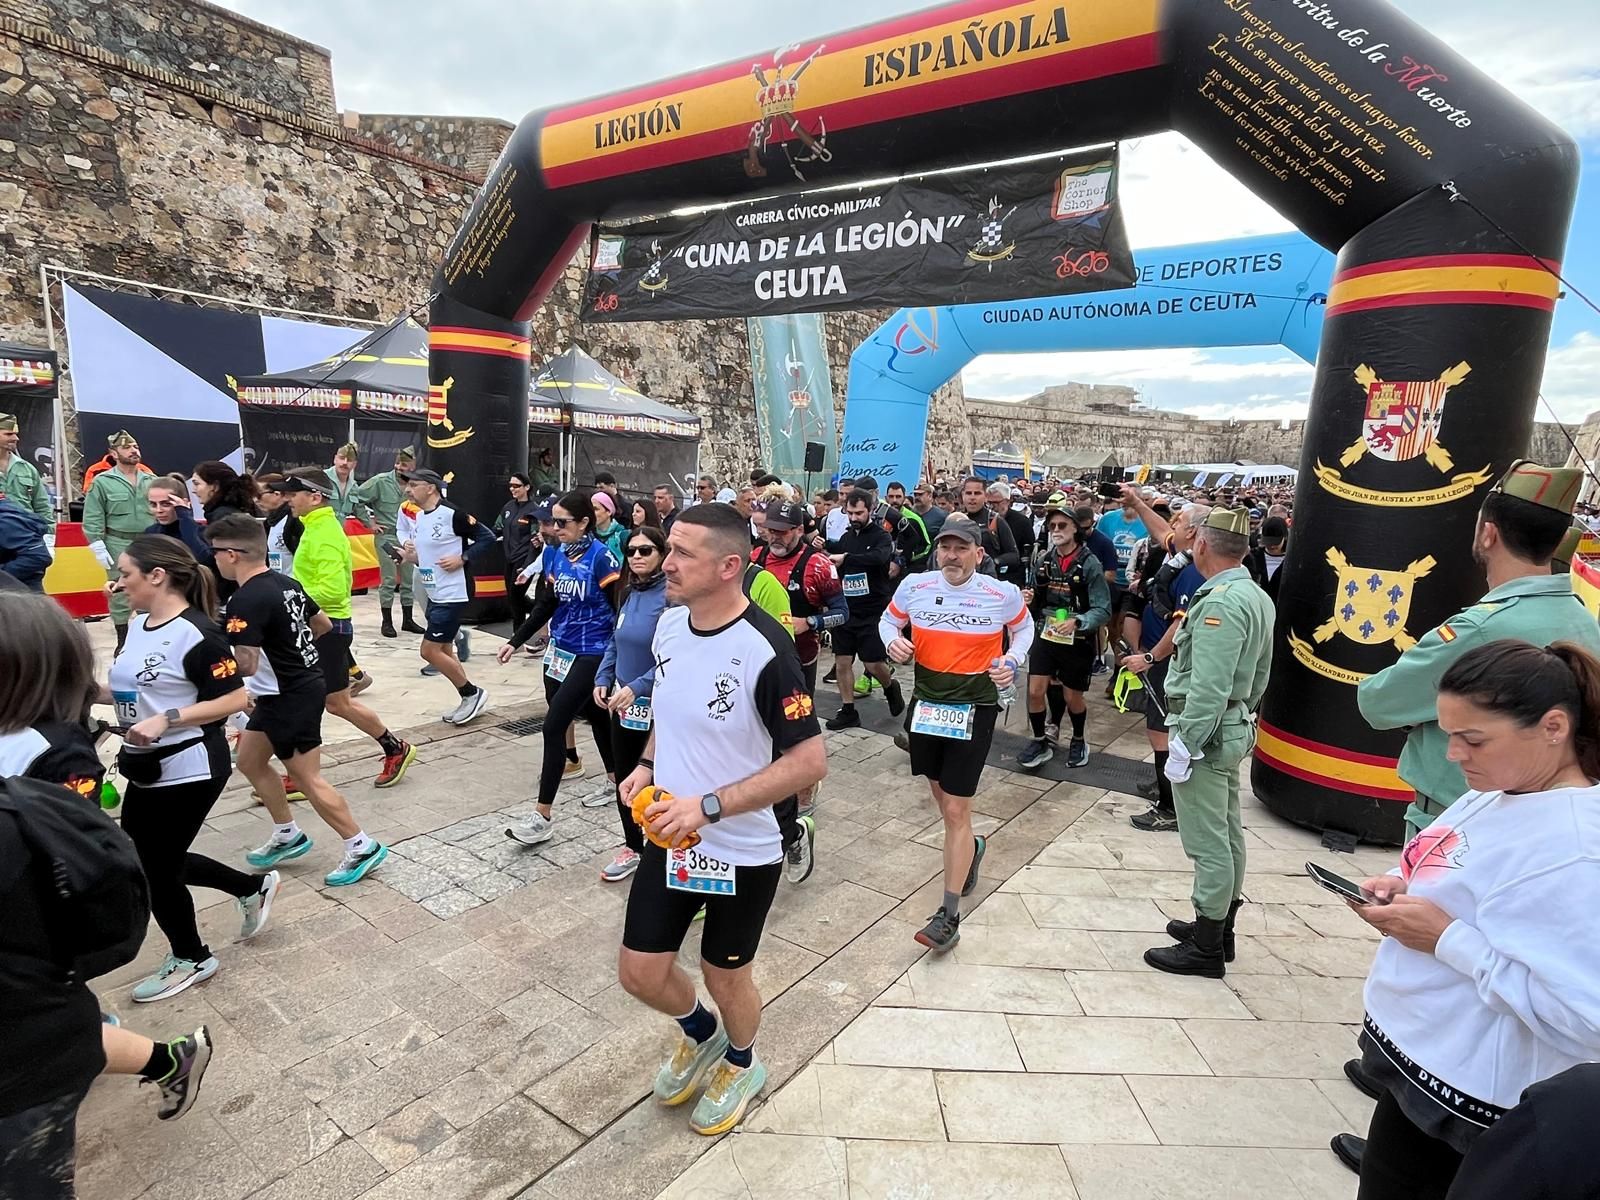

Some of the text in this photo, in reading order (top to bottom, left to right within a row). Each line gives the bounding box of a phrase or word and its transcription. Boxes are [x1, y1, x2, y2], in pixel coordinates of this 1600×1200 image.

[593, 6, 1071, 149] LEGIÓN ESPAÑOLA
[1235, 27, 1386, 155] No se muere más que una vez.
[1241, 10, 1271, 33] morir
[1269, 31, 1285, 45] en
[1283, 42, 1304, 52] el
[1294, 51, 1339, 85] combate
[1336, 82, 1352, 94] es
[1348, 92, 1372, 103] el
[1360, 101, 1398, 130] mayor
[1396, 126, 1434, 160] honor.
[1337, 28, 1369, 47] de
[1359, 43, 1389, 64] la
[1384, 55, 1472, 128] Muerte
[1208, 33, 1385, 182] La muerte llega sin dolor y el morir
[1198, 76, 1215, 100] Lo
[1214, 98, 1235, 116] más
[1234, 112, 1275, 147] horrible
[1272, 145, 1285, 157] es
[1285, 156, 1311, 177] vivir
[1207, 68, 1353, 189] no es tan horrible como parece.
[1236, 137, 1249, 151] un
[736, 196, 881, 227] CARRERA CÍVICO-MILITAR
[672, 213, 965, 270] "CUNA DE LA LEGIÓN"
[753, 264, 847, 301] CEUTA
[1160, 252, 1283, 282] DEPORTES
[982, 292, 1257, 324] CIUDAD AUTÓNOMA DE CEUTA
[245, 387, 425, 413] CLUB DEPORTIVO TERCIO
[573, 411, 615, 430] TERCIO
[883, 442, 899, 451] es
[840, 461, 899, 478] Deporte
[1321, 477, 1337, 489] TERCIO
[1351, 490, 1368, 499] JUAN
[1447, 484, 1473, 496] LEGIÓN
[934, 708, 964, 724] 3909
[1418, 1069, 1464, 1106] DKNY
[1468, 1104, 1501, 1120] SPOR
